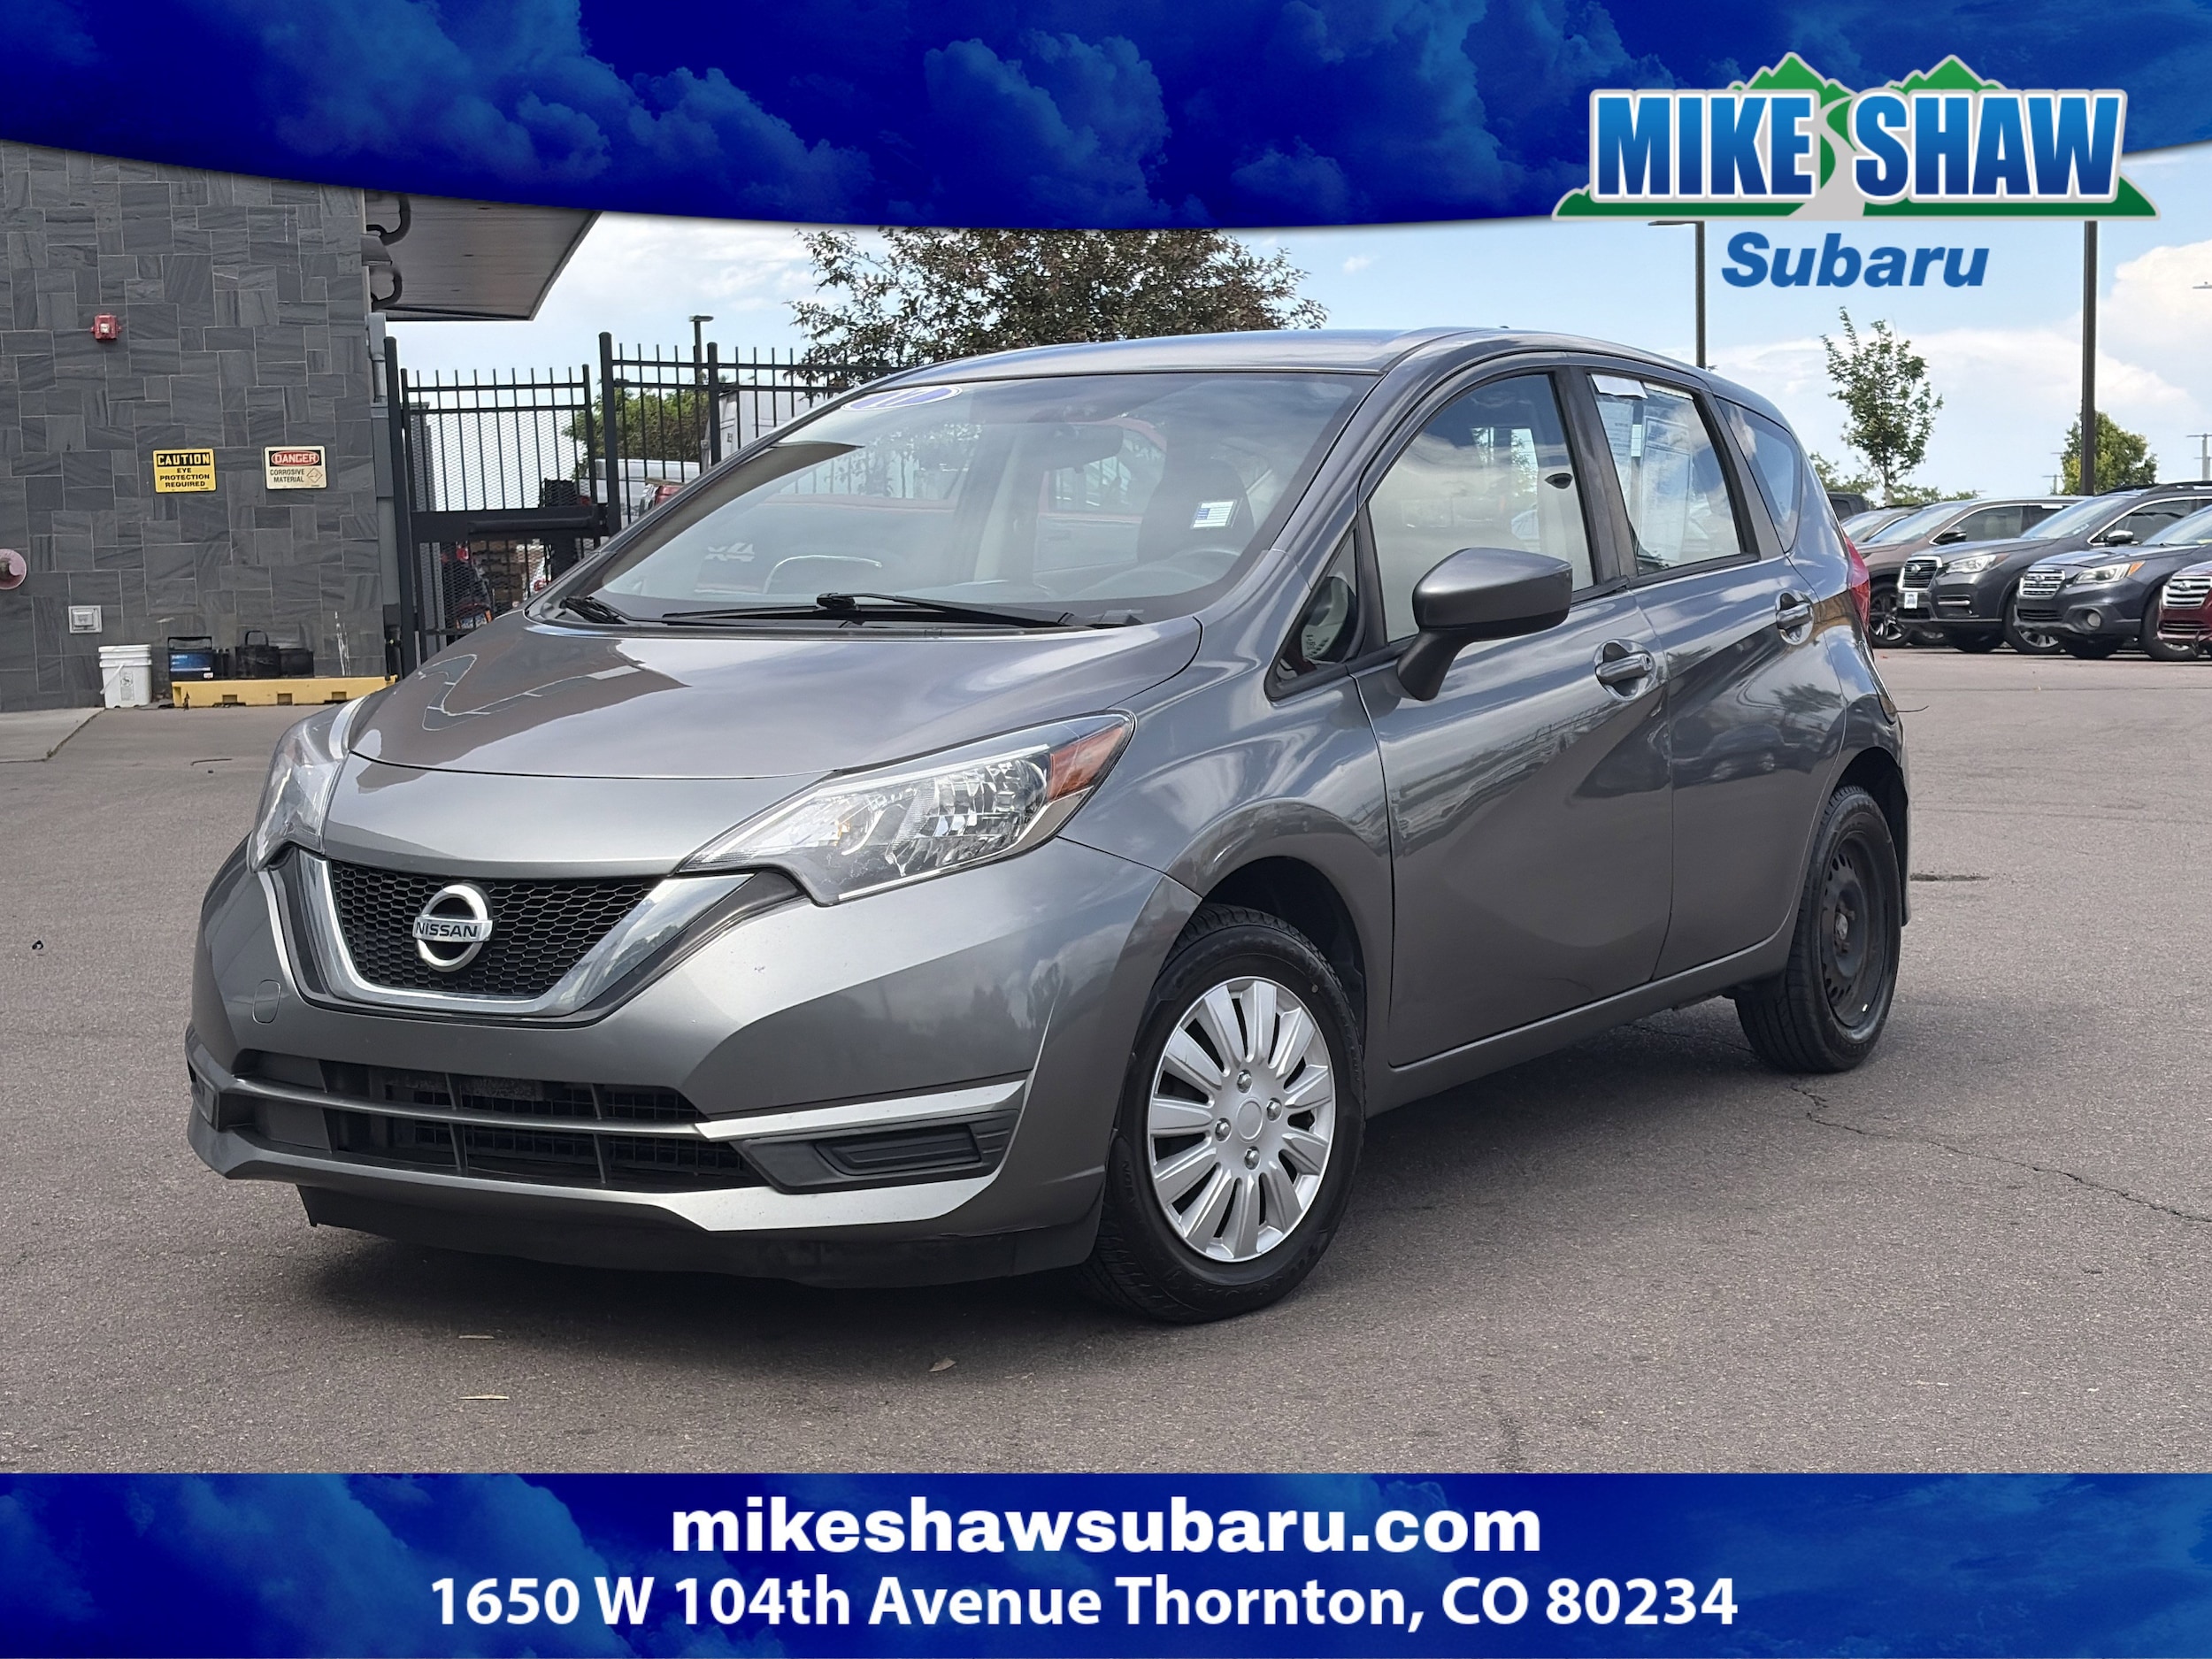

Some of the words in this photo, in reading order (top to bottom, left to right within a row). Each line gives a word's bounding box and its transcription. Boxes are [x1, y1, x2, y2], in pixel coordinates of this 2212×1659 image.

[157, 454, 210, 465] CAUTION
[275, 454, 316, 464] DANGER
[416, 922, 478, 938] NISSAN
